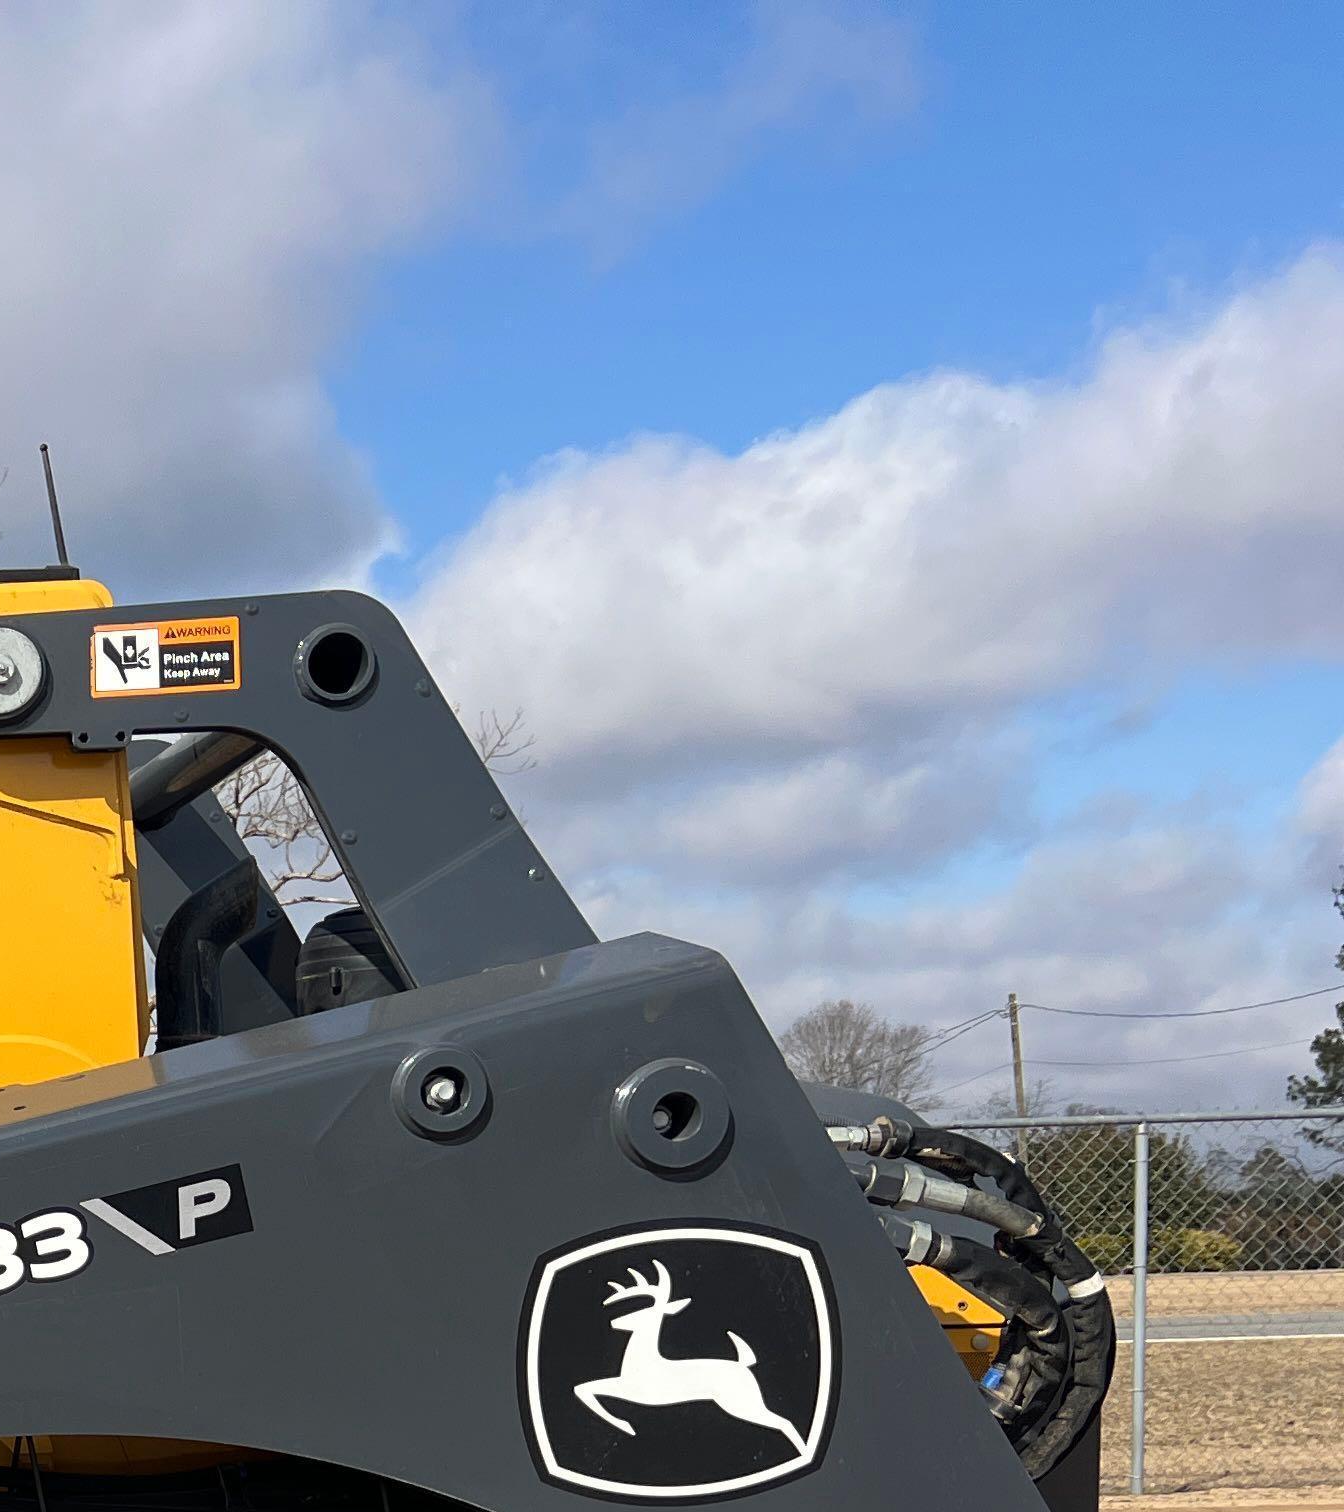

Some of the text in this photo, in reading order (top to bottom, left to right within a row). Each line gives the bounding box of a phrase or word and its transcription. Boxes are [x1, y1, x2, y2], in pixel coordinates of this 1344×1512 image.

[176, 624, 231, 638] WARNING
[163, 650, 230, 665] Pinch Area
[163, 667, 221, 680] Keep Away
